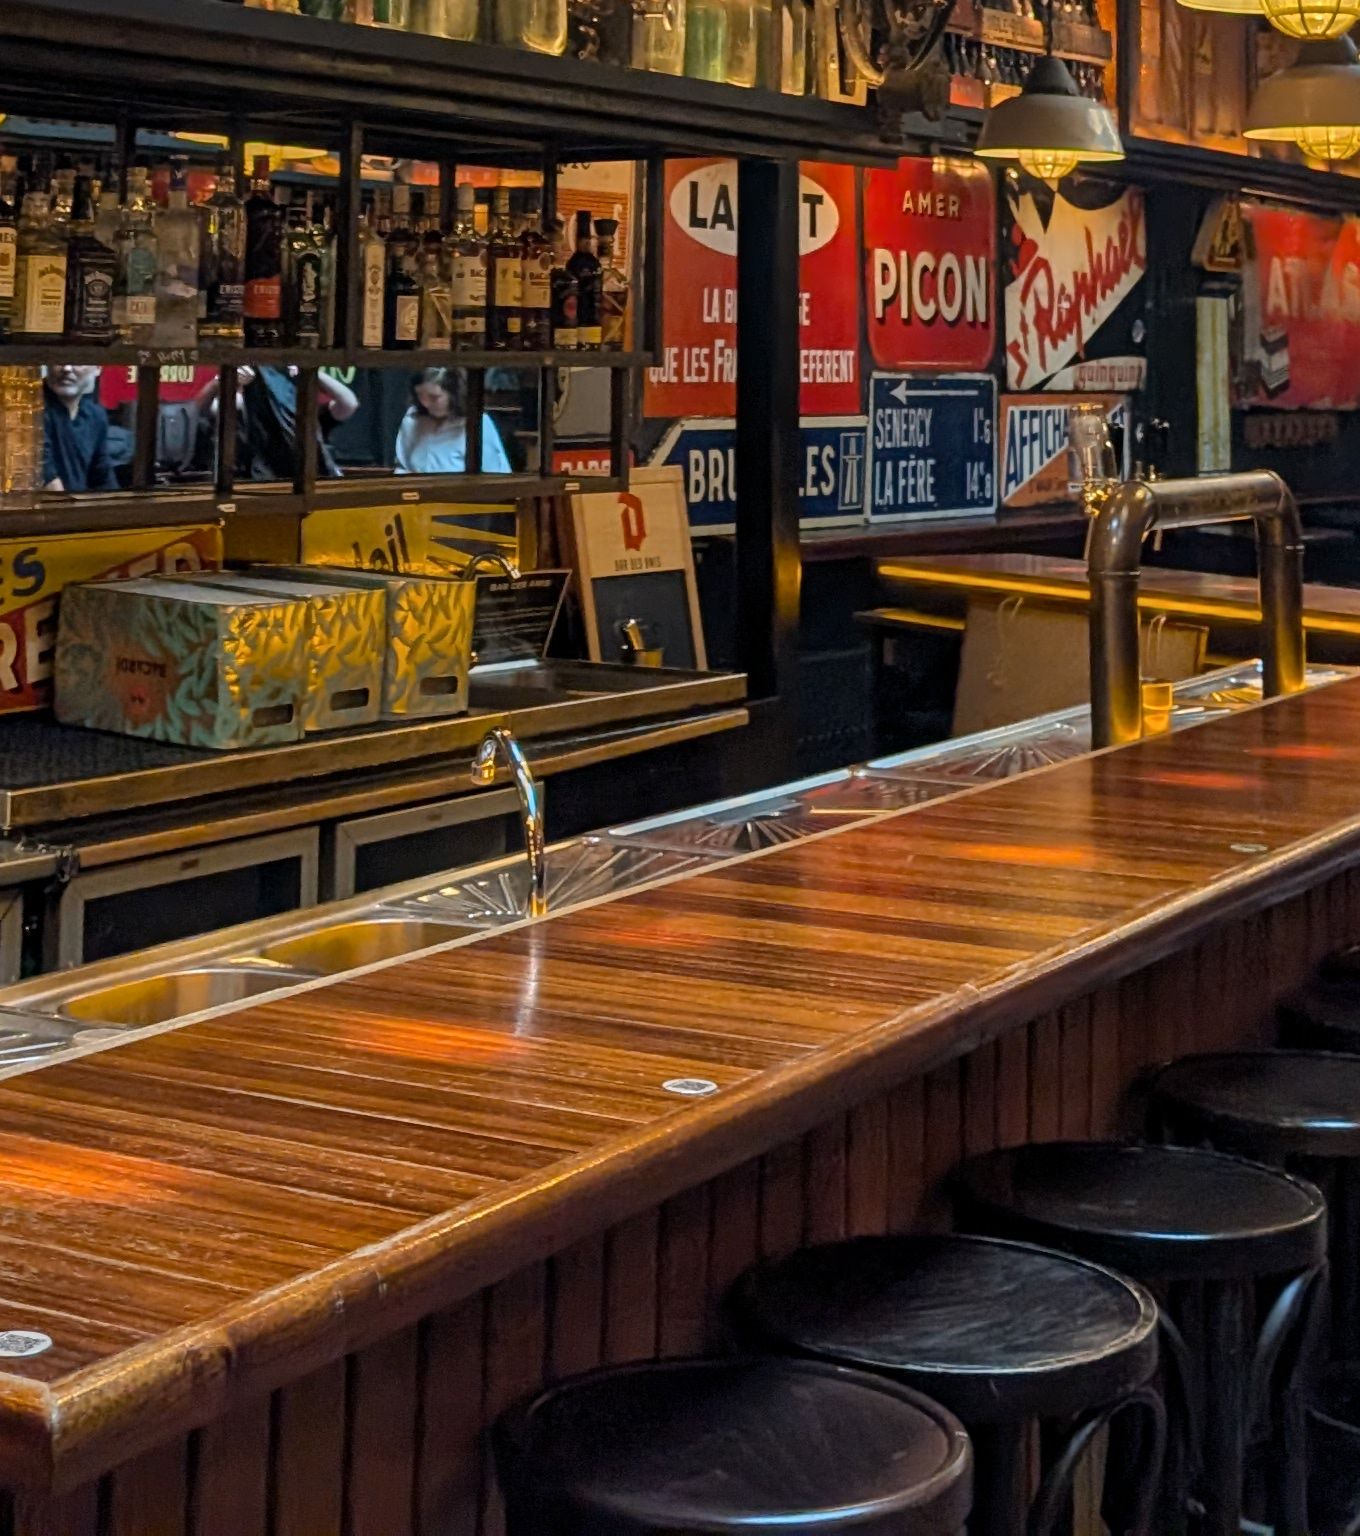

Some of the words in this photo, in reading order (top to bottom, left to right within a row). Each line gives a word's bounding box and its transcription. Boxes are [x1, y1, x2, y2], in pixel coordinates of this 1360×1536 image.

[688, 180, 825, 238] LAT
[901, 189, 961, 217] AMER
[703, 287, 720, 323] LA
[873, 248, 988, 324] PICON
[683, 347, 710, 383] LES
[800, 350, 855, 383] EFERENT
[875, 408, 933, 449] SENERCY
[875, 460, 894, 505] LA
